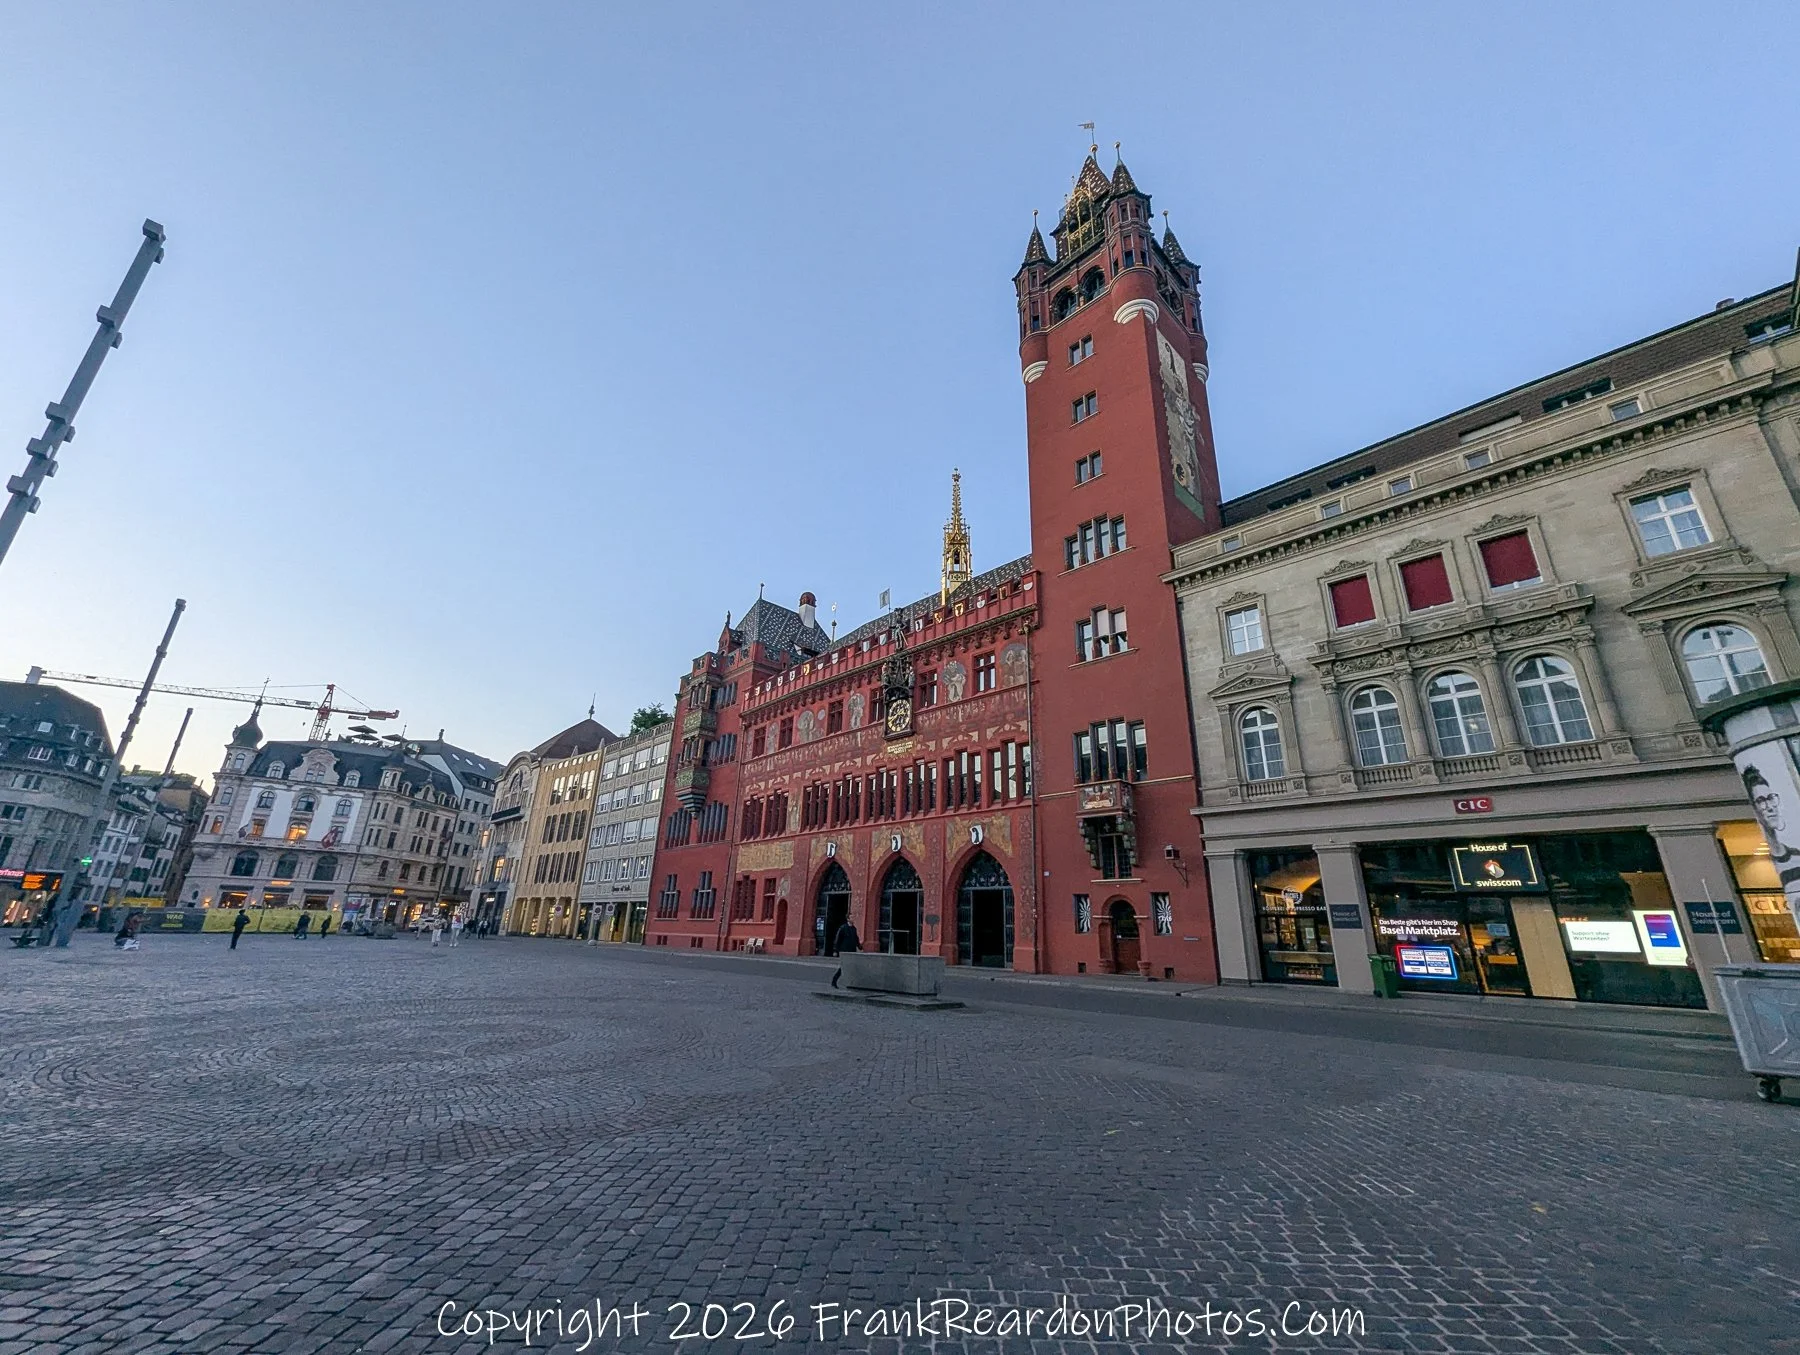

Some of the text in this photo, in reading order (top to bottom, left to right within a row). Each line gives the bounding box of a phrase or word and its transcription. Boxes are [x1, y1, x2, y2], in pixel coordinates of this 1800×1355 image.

[1457, 799, 1488, 811] CIC
[1471, 843, 1508, 853] House of
[1476, 879, 1522, 887] swisscom
[1380, 926, 1460, 937] Basel Marktplatz.
